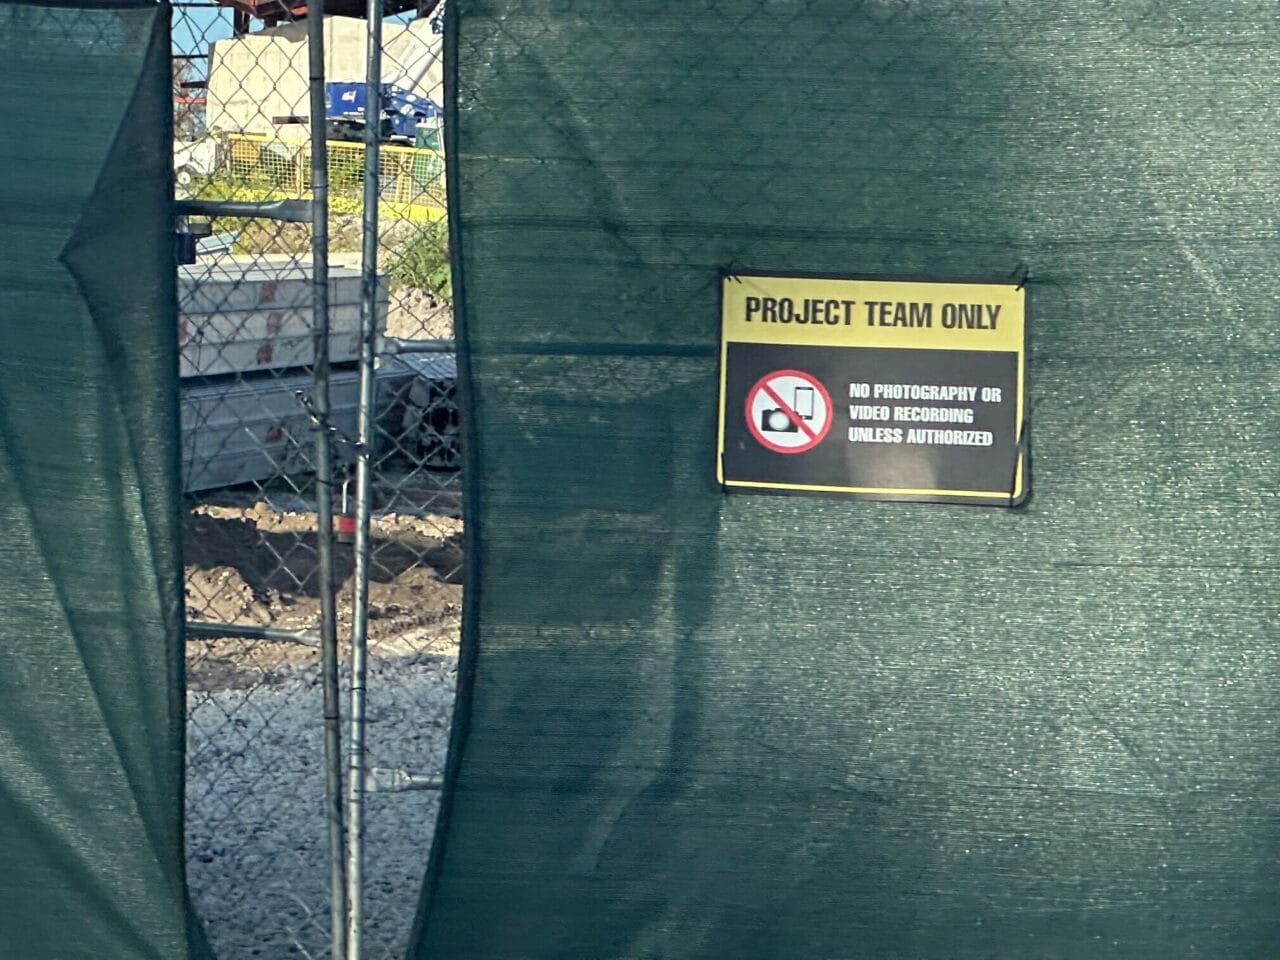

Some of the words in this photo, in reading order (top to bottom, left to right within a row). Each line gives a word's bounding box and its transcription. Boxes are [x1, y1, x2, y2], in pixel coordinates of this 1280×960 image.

[745, 296, 856, 325] PROJECT
[864, 300, 933, 328] TEAM
[941, 302, 1002, 330] ONLY
[849, 382, 870, 399] NO
[873, 384, 977, 402] PHOTOGRAPHY
[981, 385, 1002, 403] OR
[849, 405, 890, 421] VIDEO
[894, 407, 974, 424] RECORDING
[848, 427, 902, 444] UNLESS
[906, 429, 993, 446] AUTHORIZED
